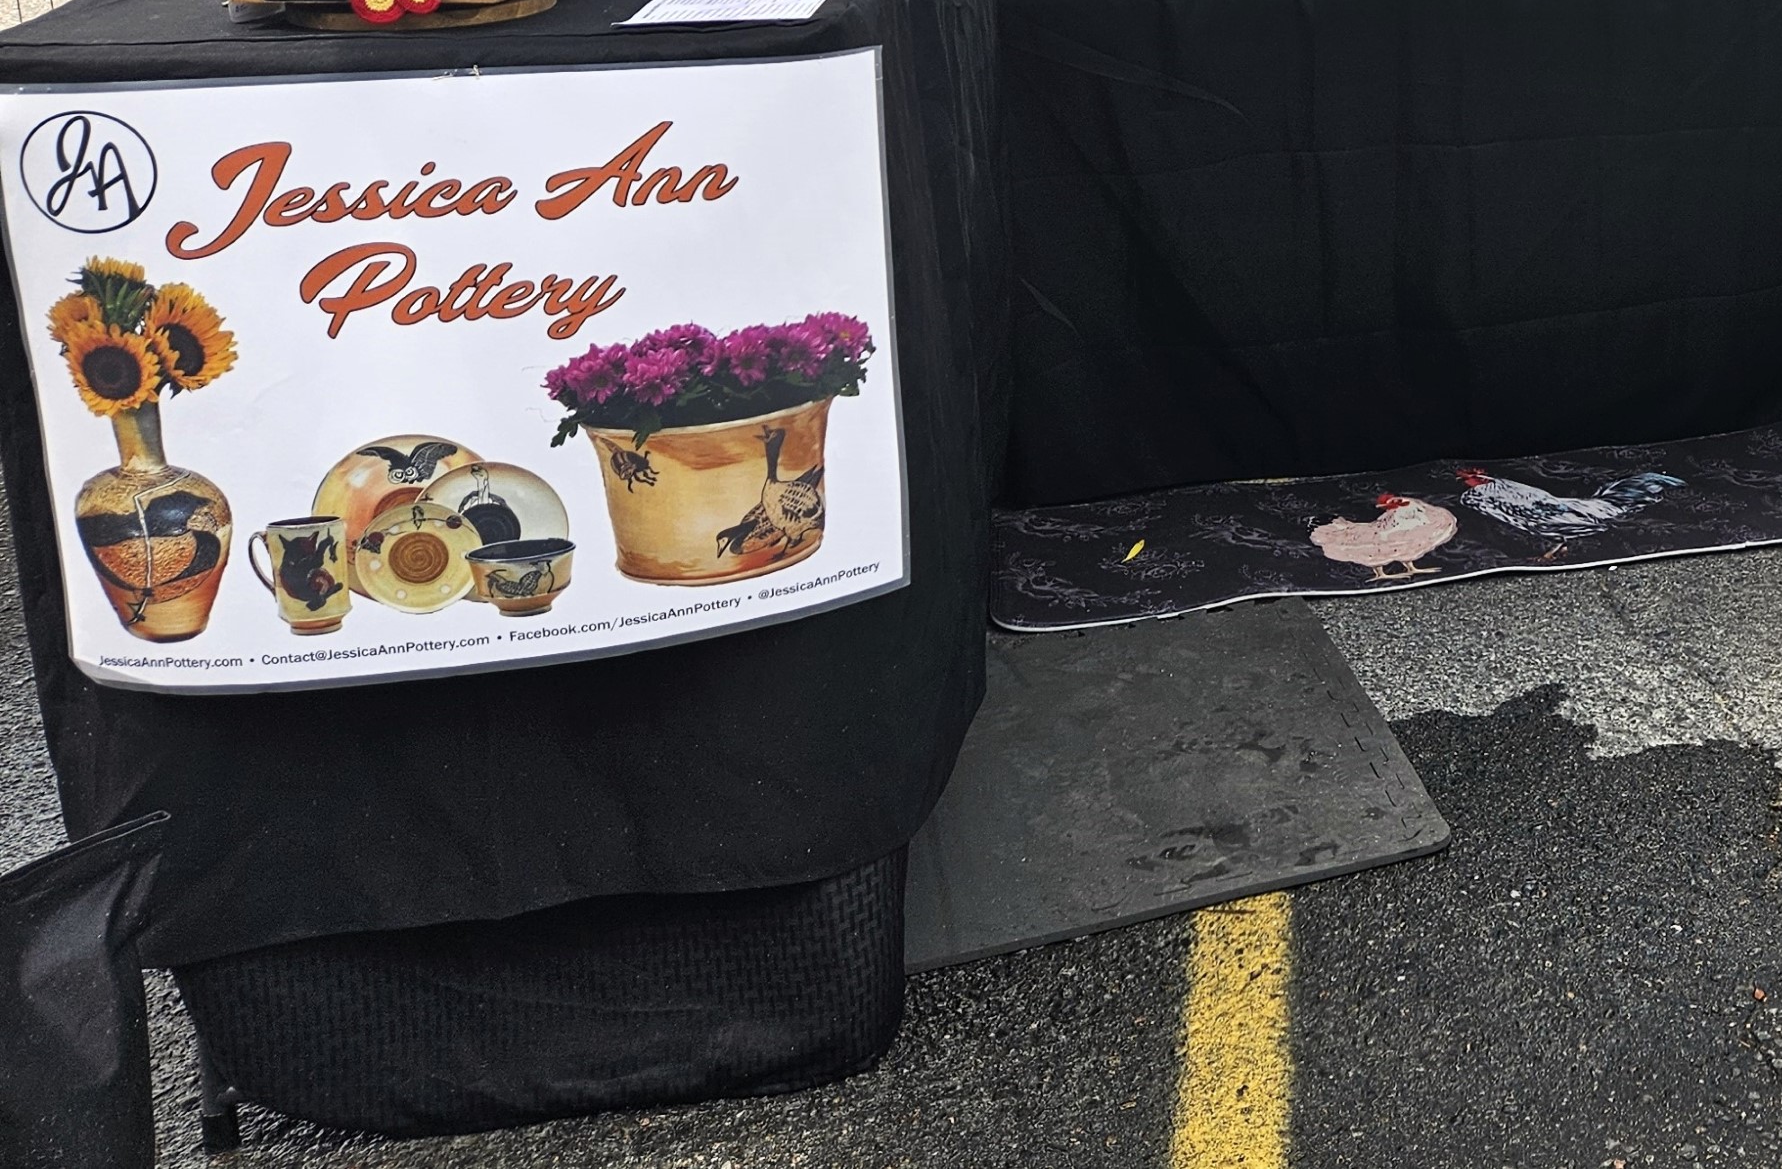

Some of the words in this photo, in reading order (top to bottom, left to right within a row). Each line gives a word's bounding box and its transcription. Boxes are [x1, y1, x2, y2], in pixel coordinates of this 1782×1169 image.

[165, 140, 519, 261] Jessica
[535, 120, 740, 221] Ann
[299, 241, 627, 341] Pottery
[98, 654, 244, 671] JessicaAnnPottery.com
[261, 633, 491, 666] Contact@JessicaAnnPottery.com
[509, 595, 742, 643] Facebook.com/JessicaAnnPottery
[758, 560, 881, 600] @JessicaAnnPottery
